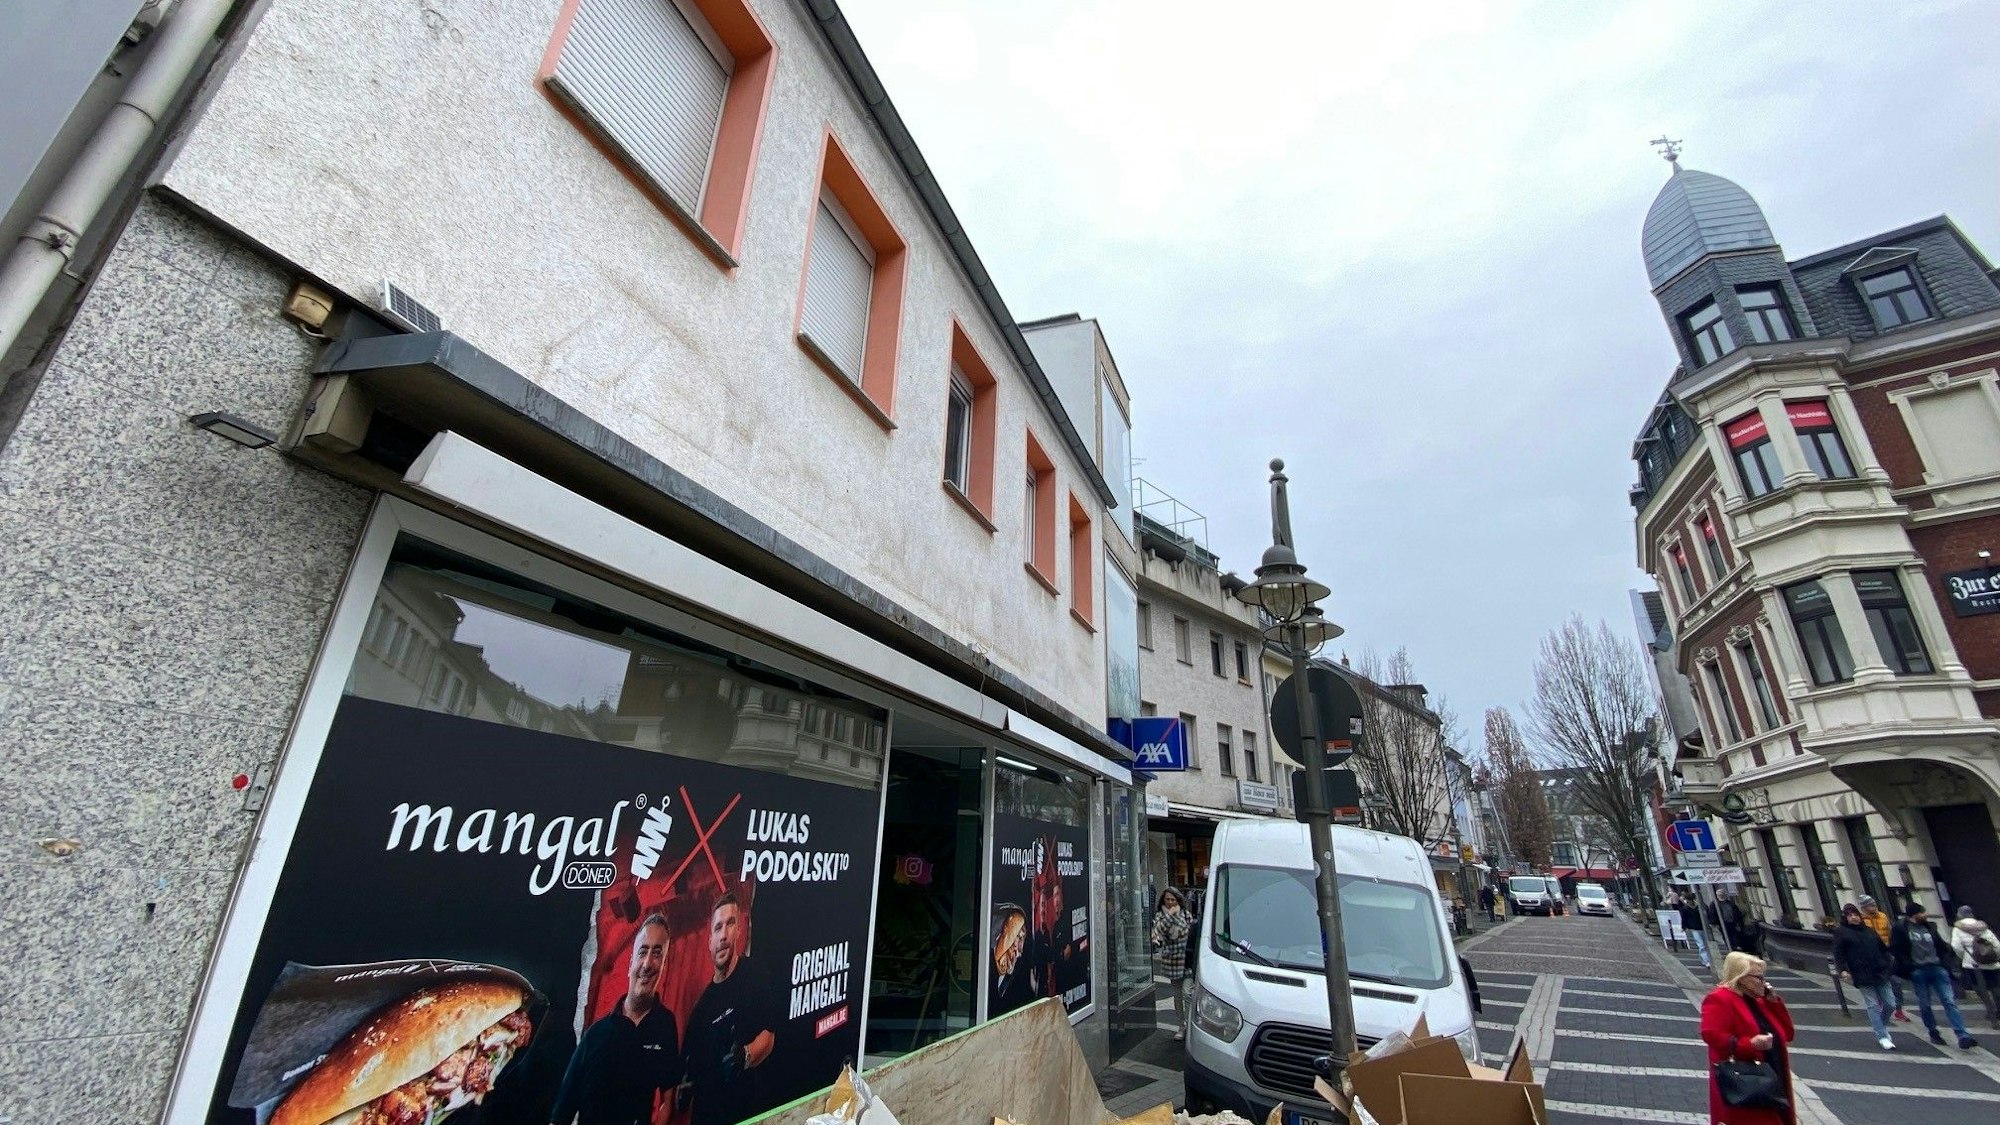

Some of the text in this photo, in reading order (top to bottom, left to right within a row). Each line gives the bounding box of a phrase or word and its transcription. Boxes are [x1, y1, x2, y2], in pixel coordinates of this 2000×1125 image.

[1949, 577, 1987, 600] Zur
[1136, 743, 1174, 763] AXA
[386, 800, 629, 895] mangal
[746, 809, 811, 844] LUKAS
[1002, 841, 1036, 881] mangal
[566, 863, 613, 885] DÖNER
[791, 941, 850, 986] ORIGINAL
[789, 971, 848, 1020] MANGAL!
